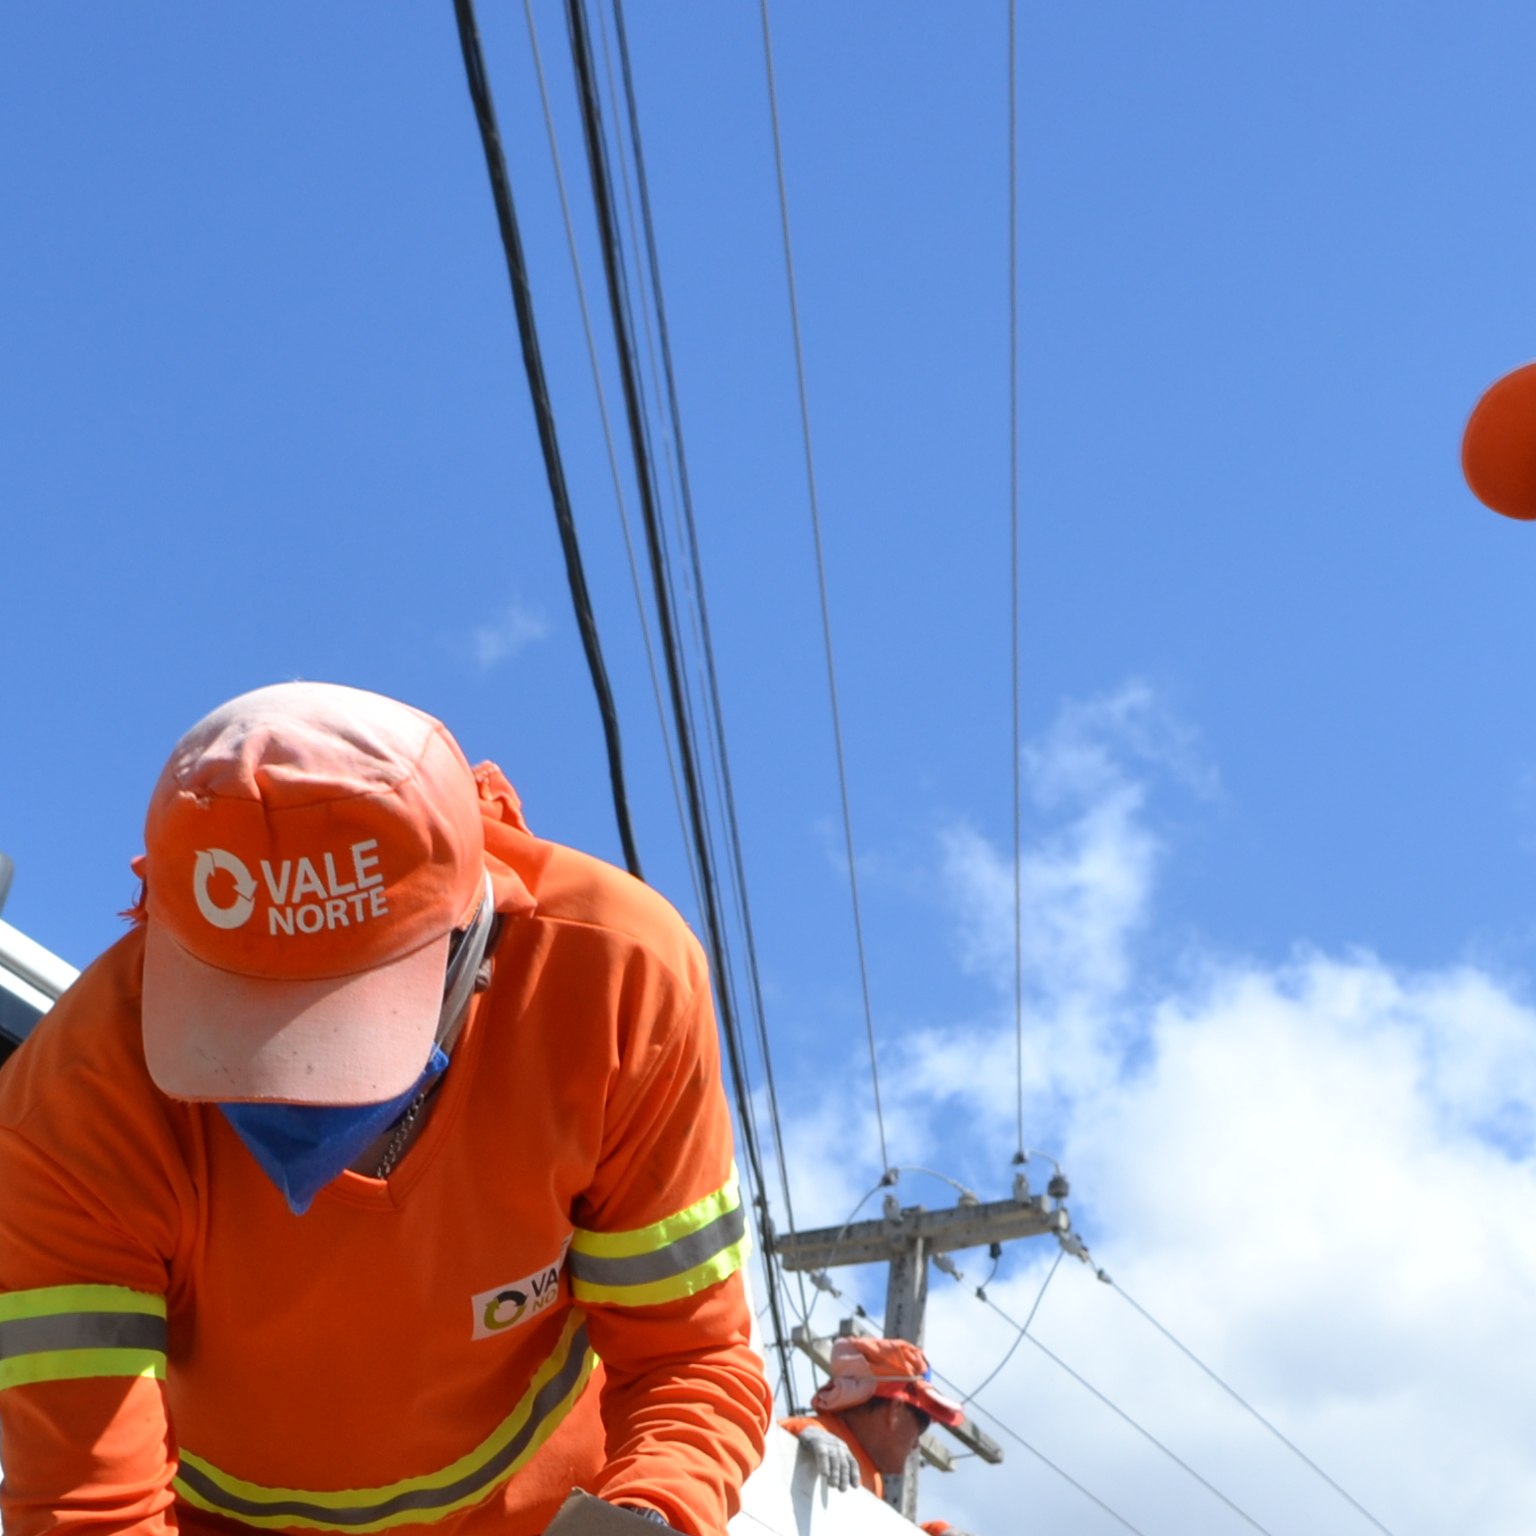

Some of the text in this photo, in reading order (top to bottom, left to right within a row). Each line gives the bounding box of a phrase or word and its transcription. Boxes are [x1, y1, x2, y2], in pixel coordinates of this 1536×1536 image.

[260, 838, 384, 907] VALE
[267, 886, 389, 936] NORTE
[530, 1267, 559, 1298] VA
